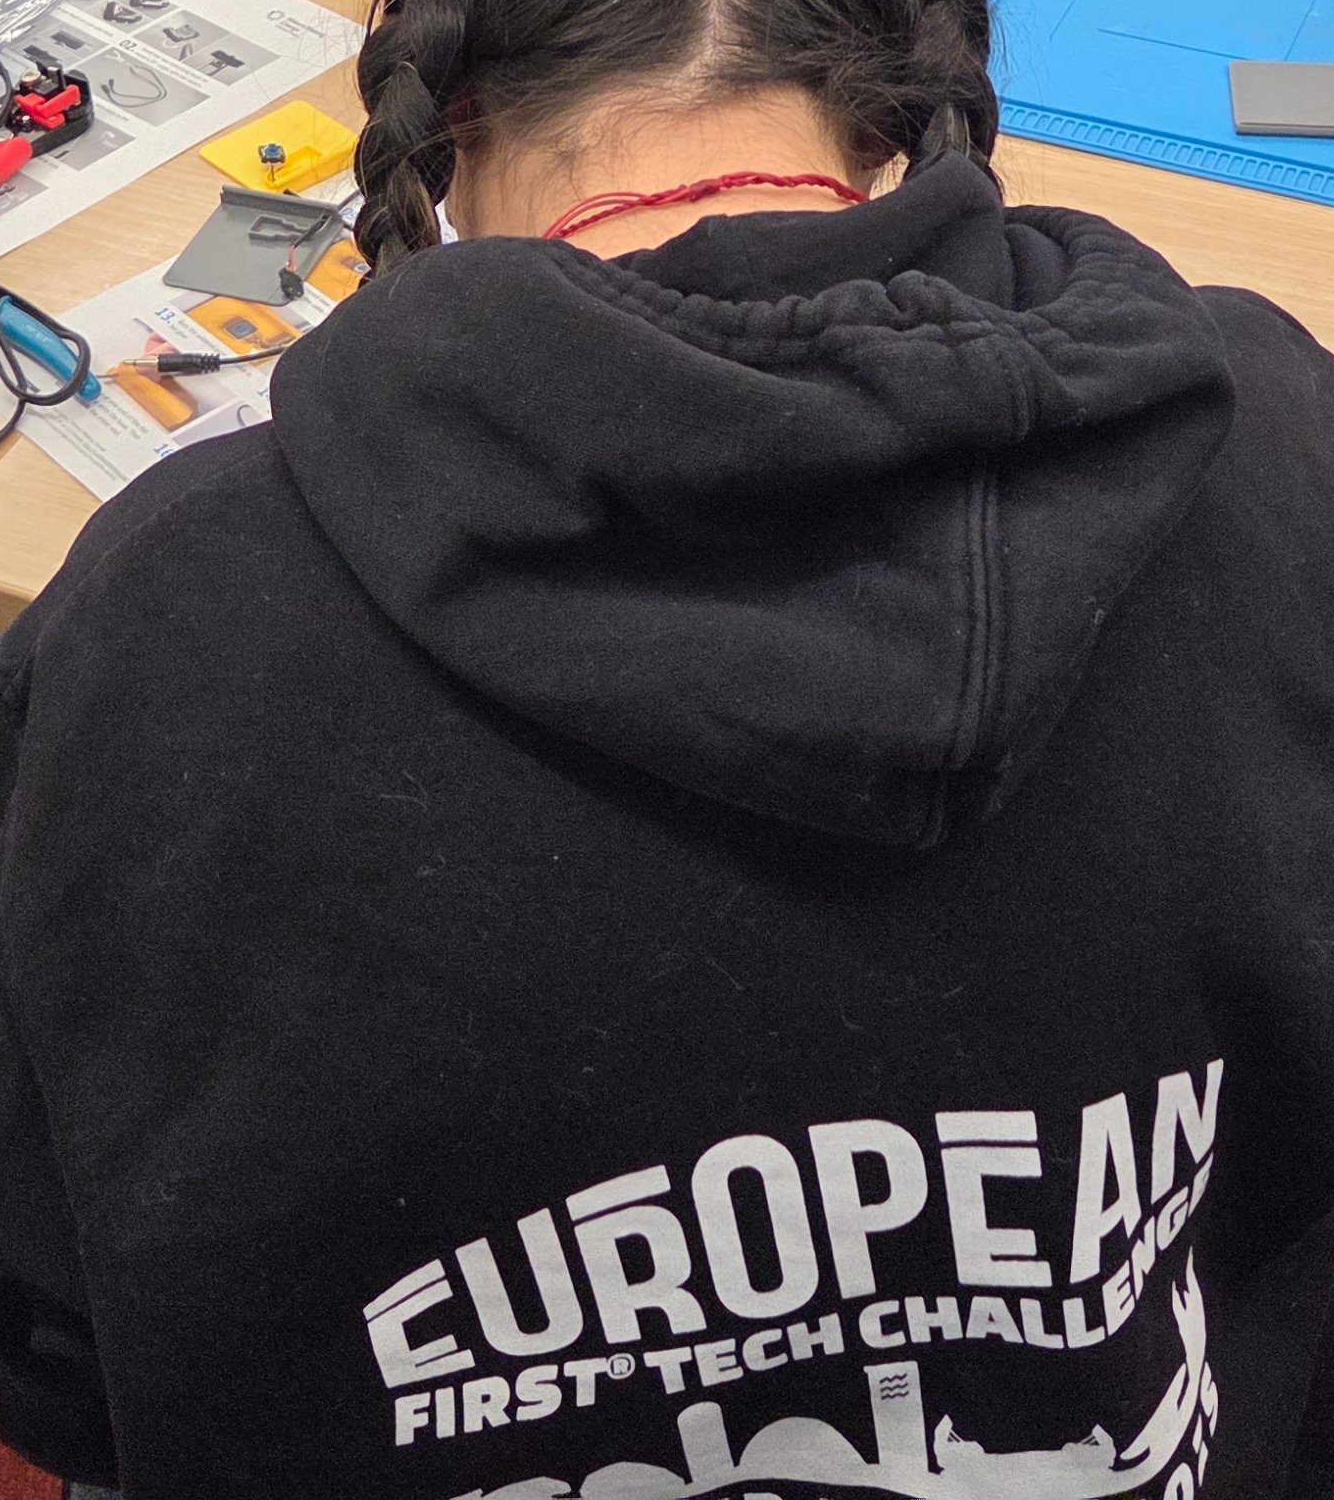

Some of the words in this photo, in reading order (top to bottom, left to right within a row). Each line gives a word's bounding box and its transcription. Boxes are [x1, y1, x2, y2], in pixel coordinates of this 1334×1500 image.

[362, 1058, 1224, 1389] EUROPEAN
[643, 1313, 845, 1395] TECH
[858, 1152, 1214, 1349] CHALLENGE
